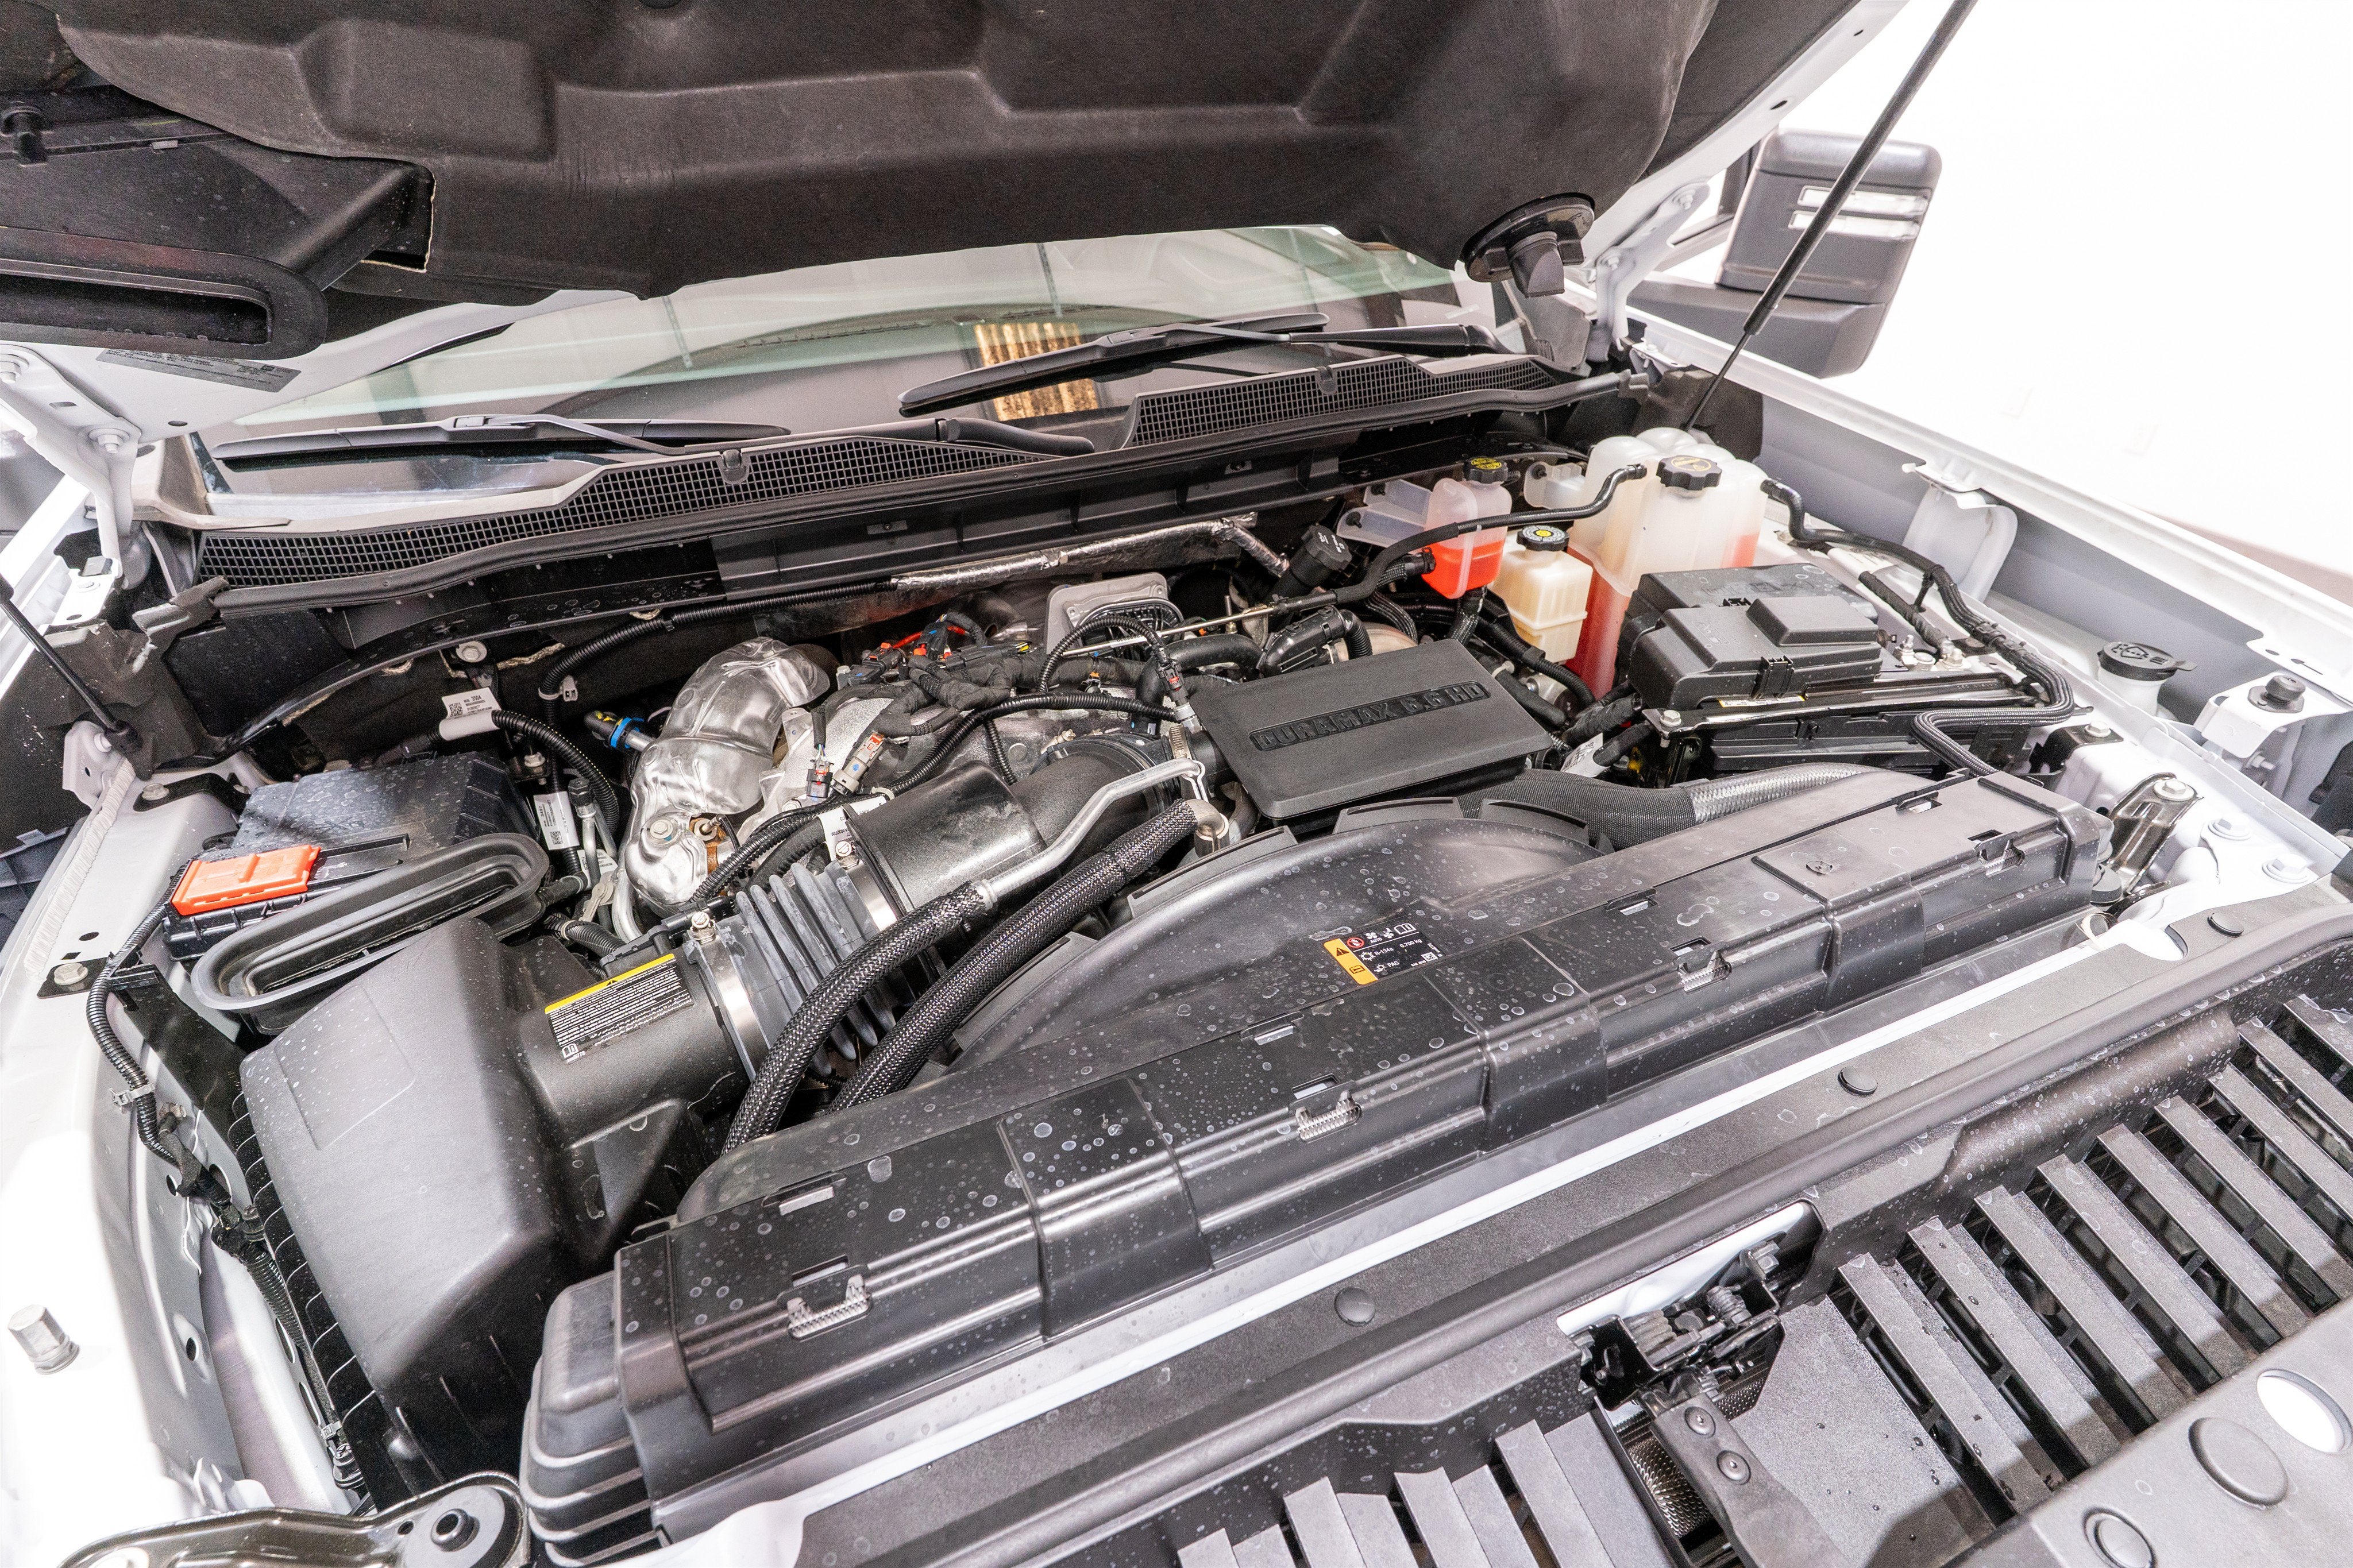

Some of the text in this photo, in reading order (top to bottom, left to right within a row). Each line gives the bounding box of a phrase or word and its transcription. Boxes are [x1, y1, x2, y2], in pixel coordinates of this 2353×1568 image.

[1255, 682, 1486, 750] DURAMAX 6.6 HD
[1374, 948, 1394, 956] R-134a
